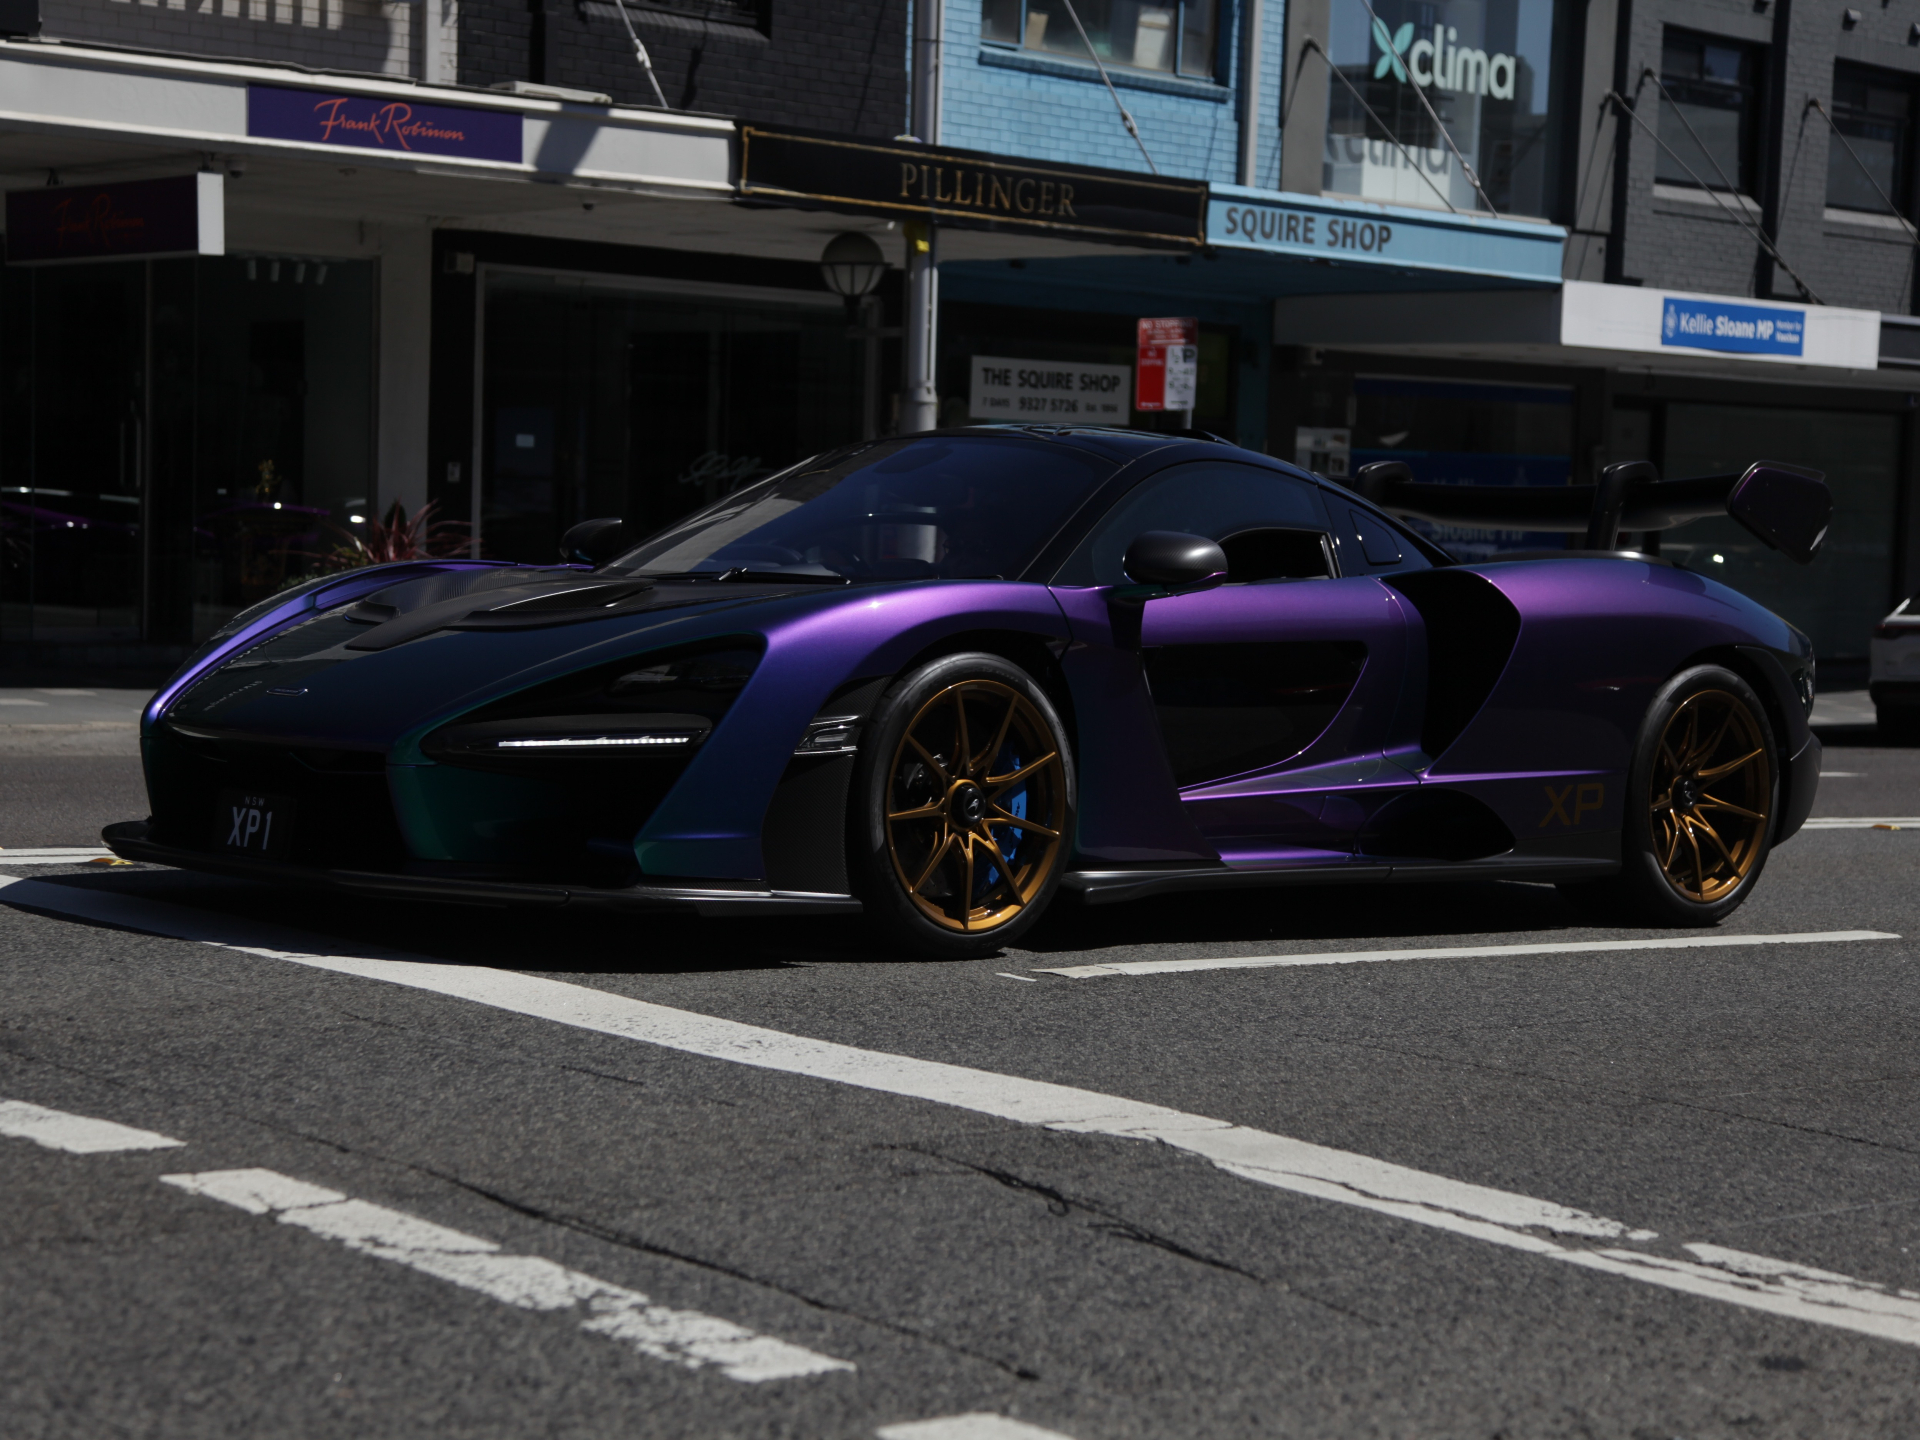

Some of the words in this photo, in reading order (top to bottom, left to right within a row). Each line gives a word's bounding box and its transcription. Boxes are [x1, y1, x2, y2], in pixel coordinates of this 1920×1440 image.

[1409, 23, 1516, 100] clima
[314, 98, 384, 144] Frank
[900, 162, 1077, 218] PILLINGER
[1226, 206, 1315, 244] SQUIRE
[1327, 219, 1391, 252] SHOP
[1679, 312, 1714, 336] Kellie
[1714, 314, 1755, 339] Sloane
[1756, 319, 1775, 340] MP
[1183, 348, 1195, 363] P
[983, 367, 1011, 386] THE
[1018, 369, 1073, 391] SQUIRE
[1079, 373, 1120, 393] SHOP
[1018, 396, 1047, 411] 9327
[1051, 398, 1078, 413] 5726
[245, 796, 265, 807] NSW
[1539, 783, 1605, 828] XP
[227, 806, 272, 850] XP1
